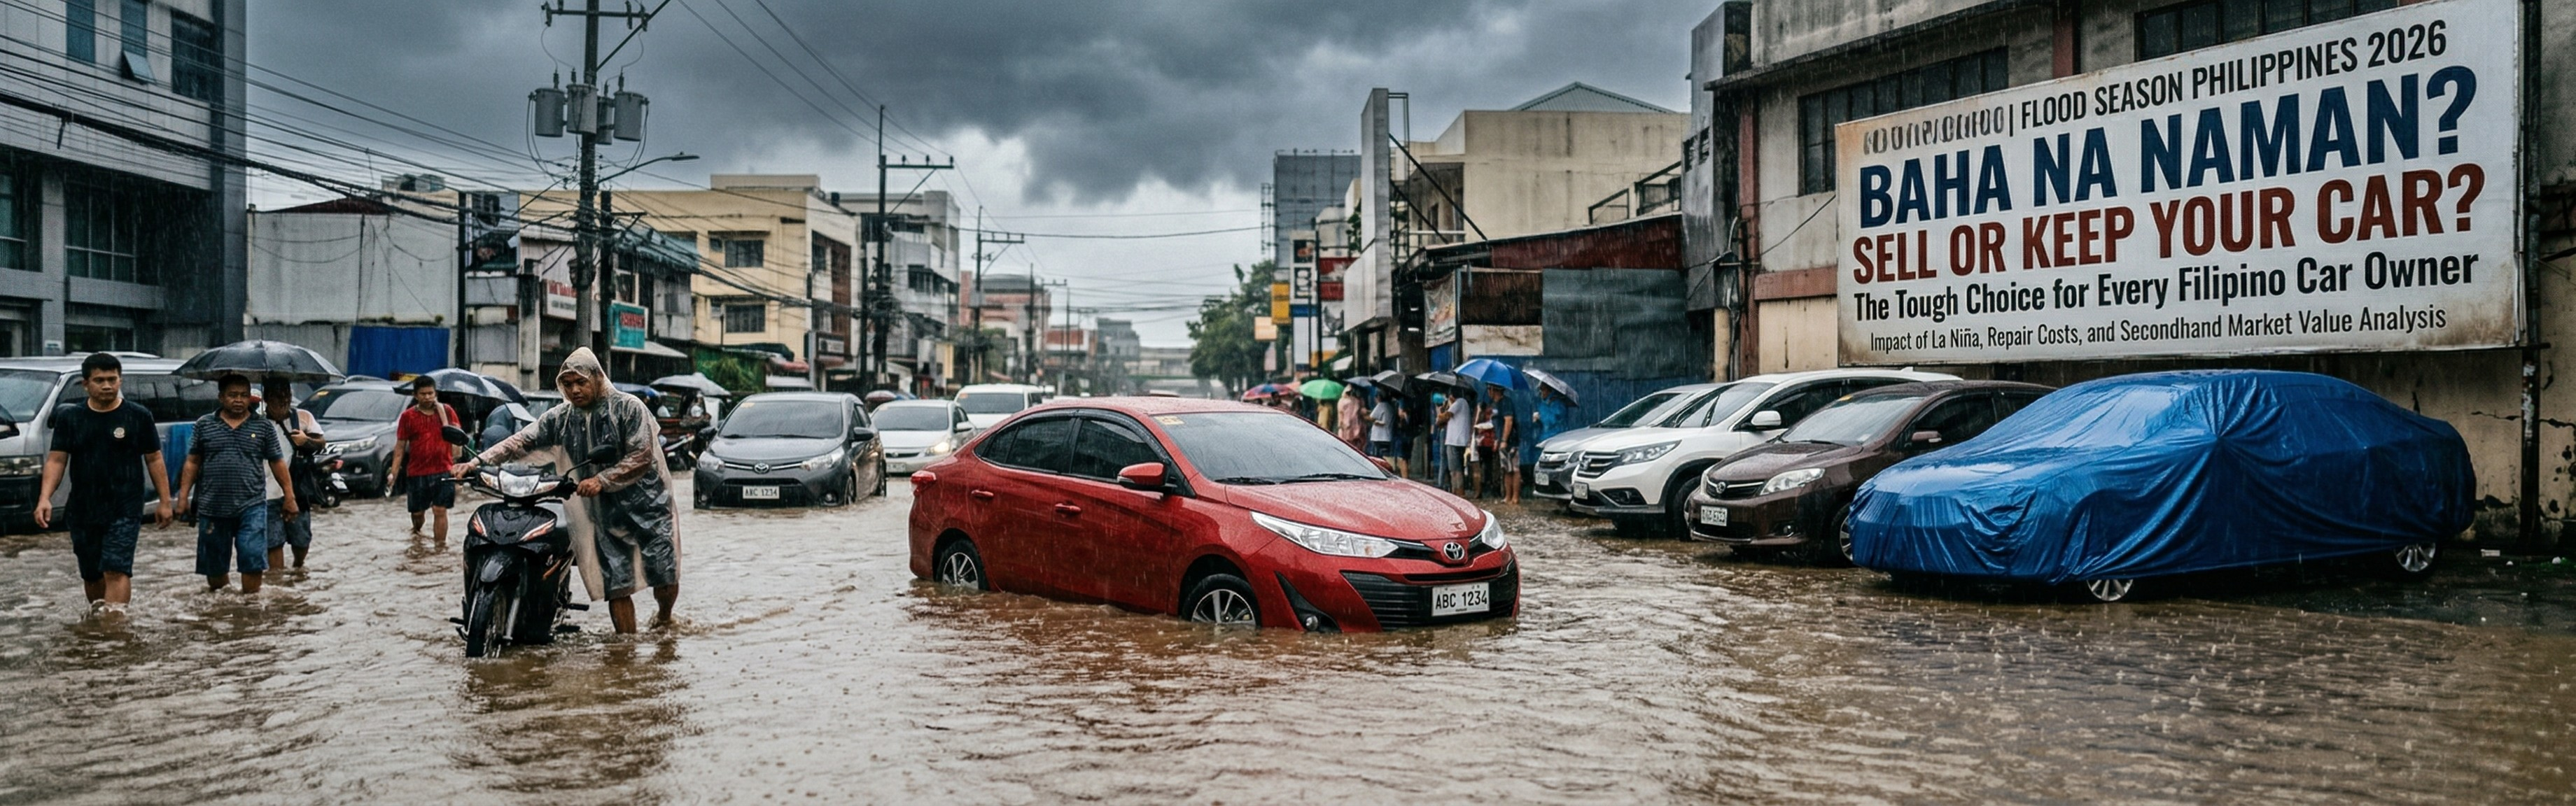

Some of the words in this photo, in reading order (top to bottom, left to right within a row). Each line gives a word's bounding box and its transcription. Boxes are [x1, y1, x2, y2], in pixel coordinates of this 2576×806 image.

[2022, 91, 2087, 129] FLOOD
[2094, 71, 2183, 117] SEASON
[2192, 36, 2358, 100] PHILIPPINES
[2367, 19, 2447, 69] 2026
[1860, 144, 2012, 229] BAHA
[2033, 127, 2118, 208] NA
[2141, 65, 2477, 194] NAMAN?
[1853, 229, 1937, 285] SELL
[1949, 222, 2006, 276] OR
[2022, 206, 2135, 270] KEEP
[2149, 187, 2296, 259] YOUR
[2317, 163, 2485, 244] CAR?
[1854, 292, 1889, 322] The
[1895, 285, 1959, 323] Tough
[1966, 281, 2045, 315] Choice
[2052, 278, 2090, 309] for
[2098, 273, 2169, 310] Every
[2178, 263, 2286, 307] Filipino
[2297, 257, 2353, 295] Car
[2365, 251, 2479, 290] Owner
[1870, 332, 1912, 355] Impact
[1915, 330, 1928, 350] of
[1932, 330, 1946, 349] La
[1950, 327, 1983, 350] Niña,
[1987, 326, 2033, 351] Repair
[2038, 323, 2082, 346] Costs,
[2087, 320, 2115, 343] and
[2120, 314, 2222, 341] Secondhand
[2228, 312, 2293, 337] Market
[2298, 309, 2353, 334] Value
[2358, 304, 2446, 334] Analysis
[1436, 593, 1456, 609] ABC
[1462, 590, 1487, 606] 1234
